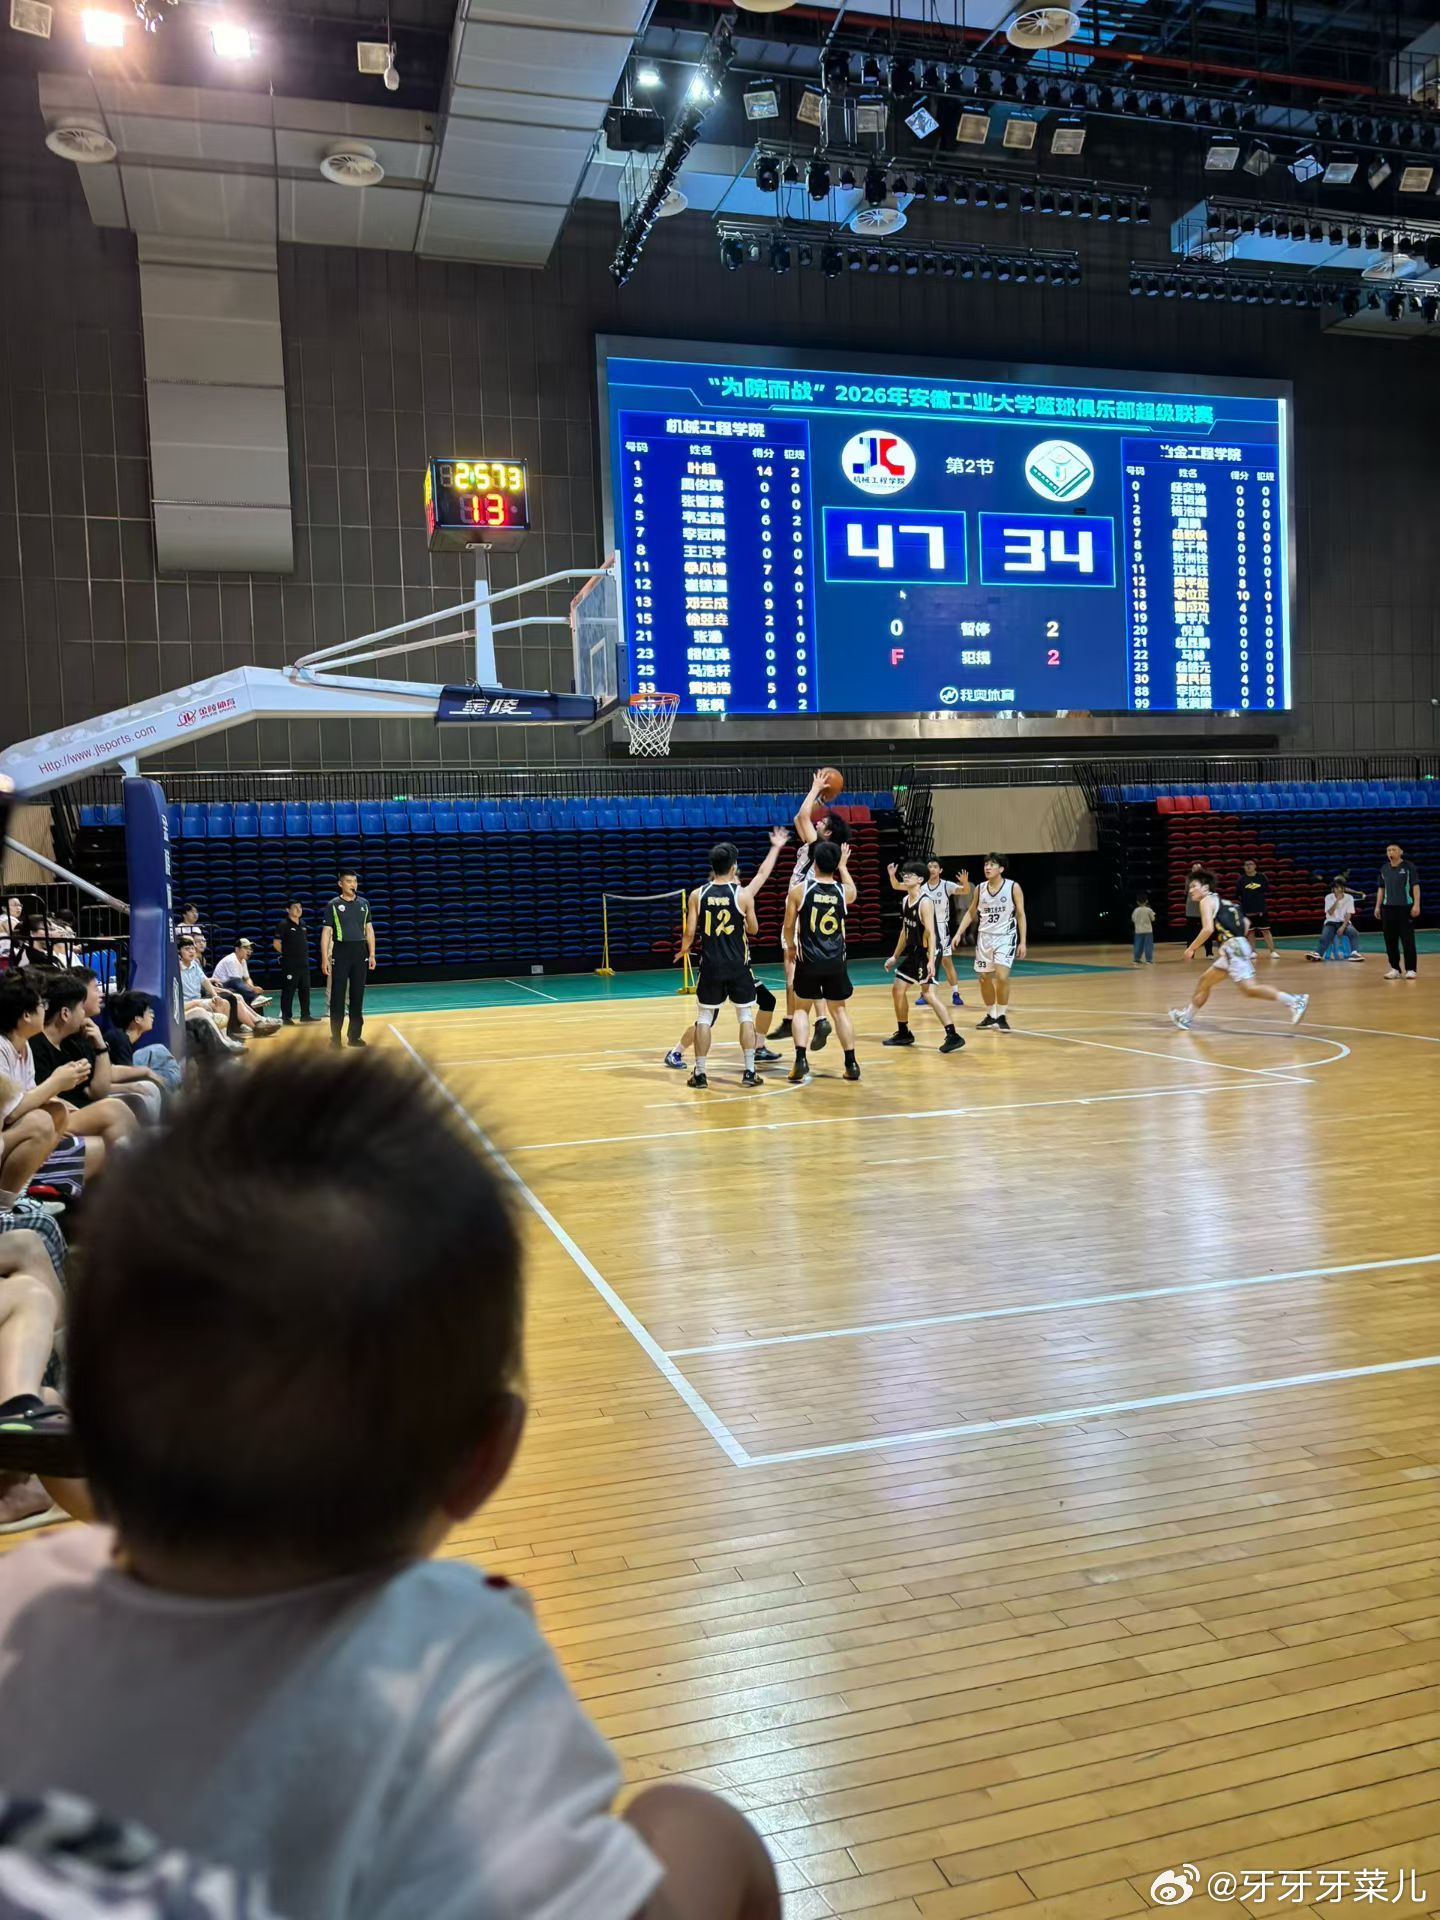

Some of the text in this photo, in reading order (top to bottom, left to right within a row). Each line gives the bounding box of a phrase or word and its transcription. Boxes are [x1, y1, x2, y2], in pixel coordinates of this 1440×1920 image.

[833, 384, 1216, 426] 2026年安徽工业大学篮球俱乐部超级联赛
[666, 418, 766, 438] 机械工程学院
[626, 442, 806, 460] 号码 姓名 得分 犯规
[634, 460, 640, 470] 1
[757, 466, 773, 476] 14
[791, 468, 799, 477] 2
[945, 456, 995, 476] 第2节
[1178, 469, 1198, 480] 姓名
[634, 477, 642, 487] 3
[760, 482, 769, 492] 0
[792, 483, 800, 493] 0
[1237, 486, 1244, 495] 0
[1262, 487, 1269, 495] 0
[634, 494, 643, 504] 4
[761, 499, 770, 509] 0
[792, 500, 801, 510] 0
[1237, 497, 1244, 507] 0
[1263, 498, 1270, 507] 0
[472, 494, 504, 525] 13
[1237, 509, 1244, 518] 0
[1263, 510, 1270, 519] 0
[636, 510, 801, 525] 5 6 2
[1237, 520, 1244, 530] 0
[1263, 521, 1270, 531] 0
[636, 527, 802, 542] 7 0 0
[1238, 532, 1245, 541] 8
[1263, 532, 1271, 542] 0
[637, 544, 646, 555] 8
[763, 548, 771, 559] 0
[794, 549, 802, 559] 0
[846, 523, 1094, 573] 47 34
[1238, 544, 1245, 553] 0
[1264, 544, 1271, 553] 0
[1238, 555, 1245, 564] 0
[1264, 556, 1271, 565] 0
[634, 561, 649, 572] 11
[764, 565, 772, 575] 7
[794, 565, 803, 575] 4
[1239, 567, 1246, 576] 0
[1264, 567, 1271, 577] 0
[635, 579, 803, 592] 12 0 0
[1239, 579, 1246, 589] 8
[1266, 579, 1270, 589] 1
[1237, 591, 1250, 600] 10
[1265, 591, 1272, 601] 0
[636, 596, 652, 607] 13
[765, 599, 773, 609] 9
[797, 599, 802, 609] 1
[1240, 603, 1247, 612] 4
[1266, 604, 1271, 613] 1
[636, 613, 652, 624] 15
[765, 615, 773, 626] 2
[797, 615, 803, 625] 1
[1240, 615, 1247, 624] 0
[1265, 615, 1272, 625] 0
[890, 619, 1060, 638] 0 暂停 2
[1240, 627, 1247, 636] 0
[1266, 627, 1273, 637] 0
[636, 630, 805, 643] 21 0 0
[1240, 639, 1247, 648] 0
[1266, 639, 1273, 649] 0
[637, 648, 805, 660] 23 0 0
[890, 648, 1060, 666] F 犯规 2
[1241, 651, 1248, 660] 0
[1266, 651, 1273, 660] 0
[638, 665, 655, 675] 25
[767, 666, 776, 676] 0
[797, 666, 806, 676] 0
[1241, 663, 1248, 672] 0
[1266, 663, 1273, 672] 0
[1241, 675, 1248, 684] 4
[1267, 675, 1274, 684] 0
[638, 682, 656, 694] 33
[768, 683, 776, 693] 5
[798, 683, 807, 693] 0
[1242, 687, 1248, 696] 0
[1267, 687, 1274, 696] 0
[768, 699, 776, 709] 4
[799, 699, 807, 709] 2
[1242, 698, 1249, 708] 0
[1267, 698, 1274, 708] 0
[705, 908, 735, 936] 12
[810, 906, 839, 935] 16
[987, 914, 1000, 923] 33
